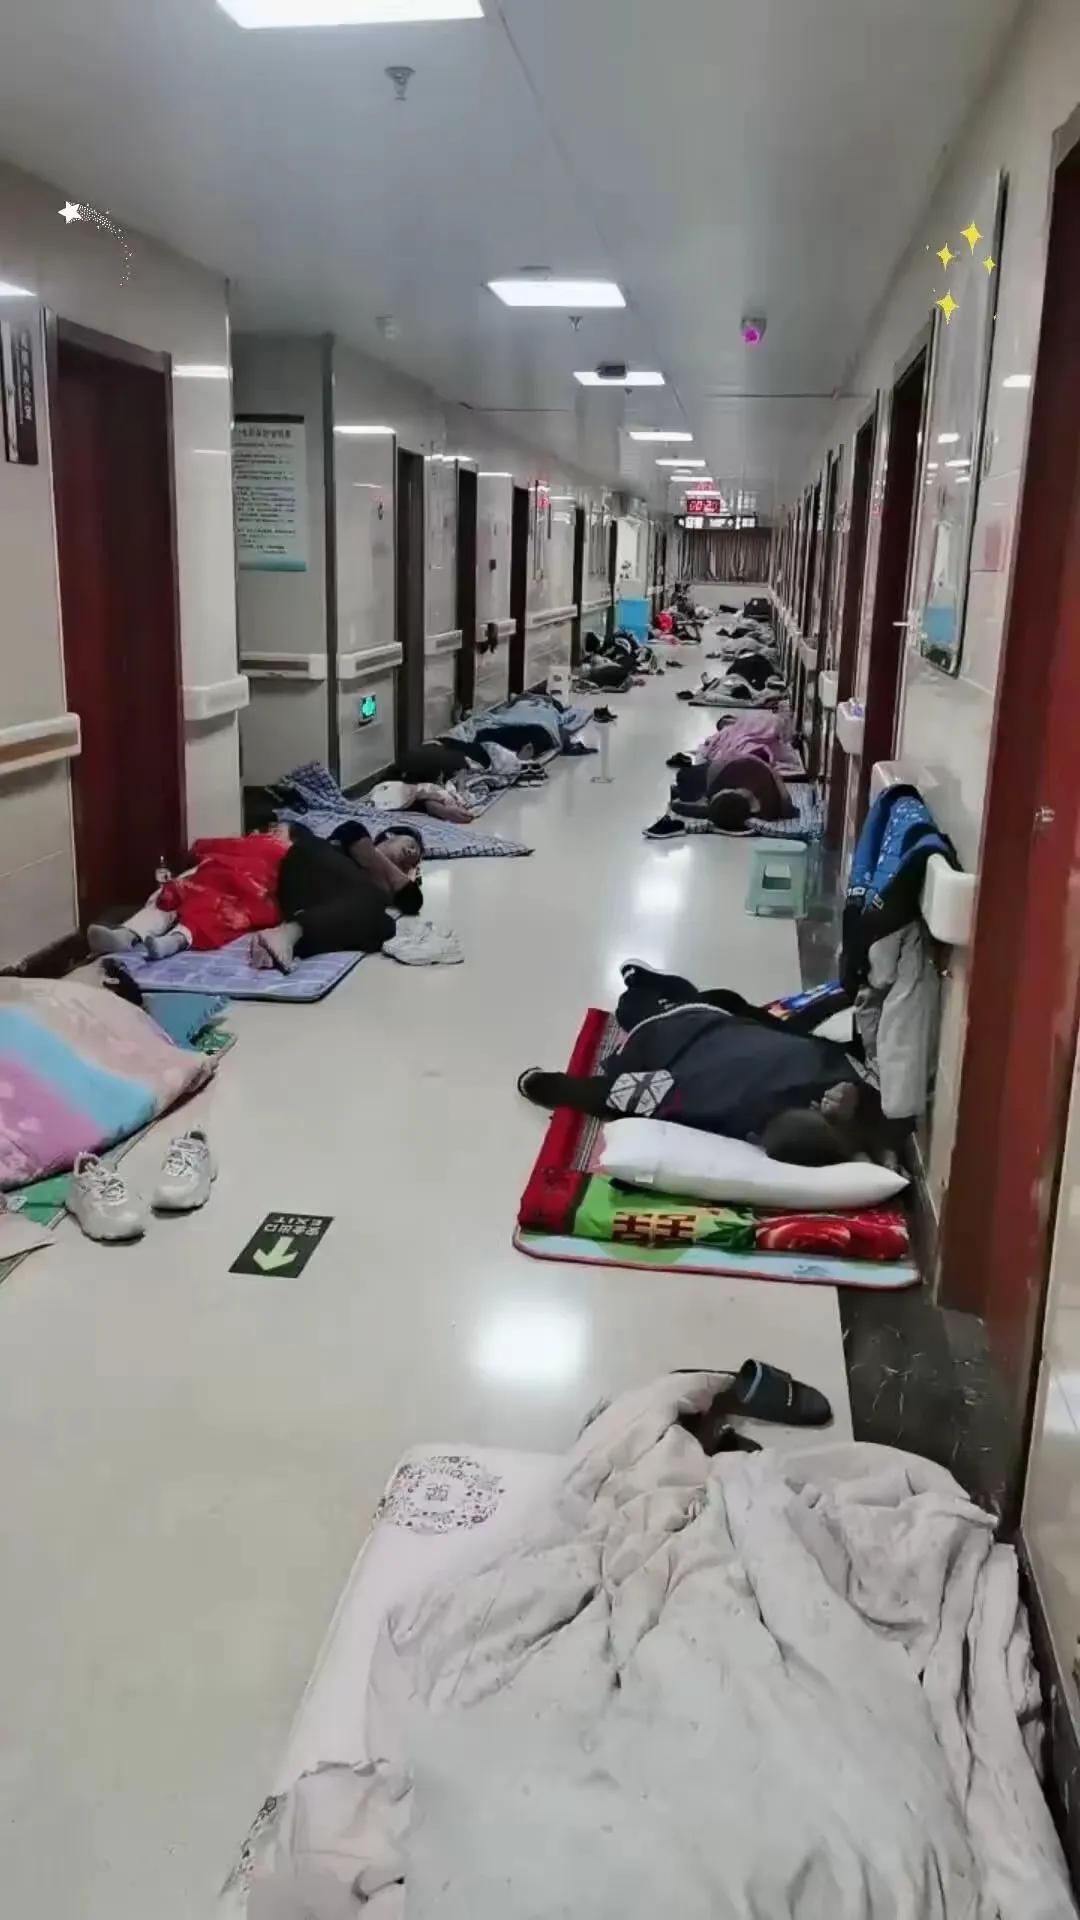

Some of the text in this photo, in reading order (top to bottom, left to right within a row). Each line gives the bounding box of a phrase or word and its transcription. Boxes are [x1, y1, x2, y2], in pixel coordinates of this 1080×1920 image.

[273, 1216, 323, 1226] EXIT
[264, 1223, 321, 1236] 安全出口
